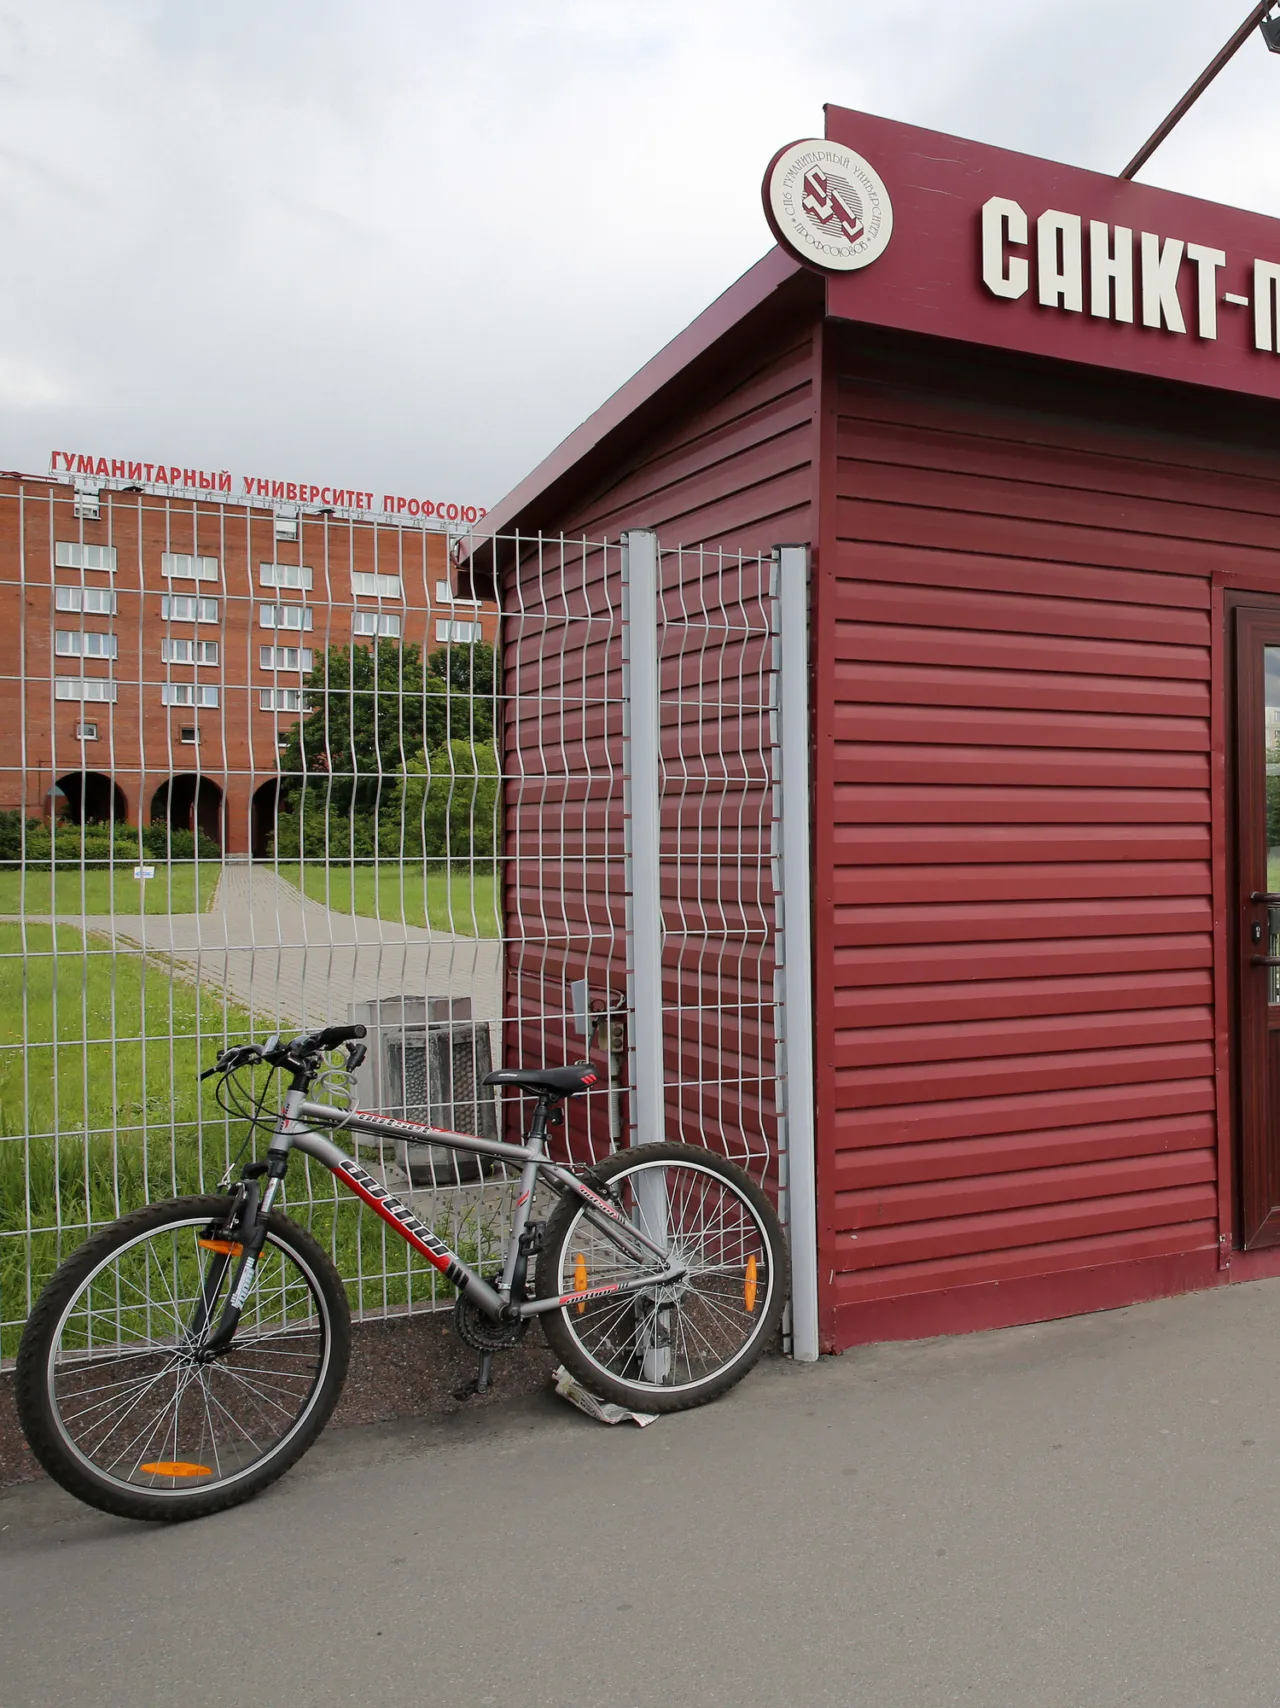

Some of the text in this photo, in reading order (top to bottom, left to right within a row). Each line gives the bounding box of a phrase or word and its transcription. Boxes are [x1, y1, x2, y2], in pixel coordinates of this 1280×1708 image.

[783, 151, 850, 188] ГУМАНИТАРНЫЙ
[853, 166, 881, 239] УНИВЕРСИТЕТ
[794, 223, 868, 257] ПРОФСОЮЗОВ
[51, 450, 487, 523] ГУМАНИТАРНЫЙ УНИВЕРСИТЕТ ПРОФСОЮЗ
[358, 1113, 432, 1134] outset
[338, 1159, 459, 1258] author
